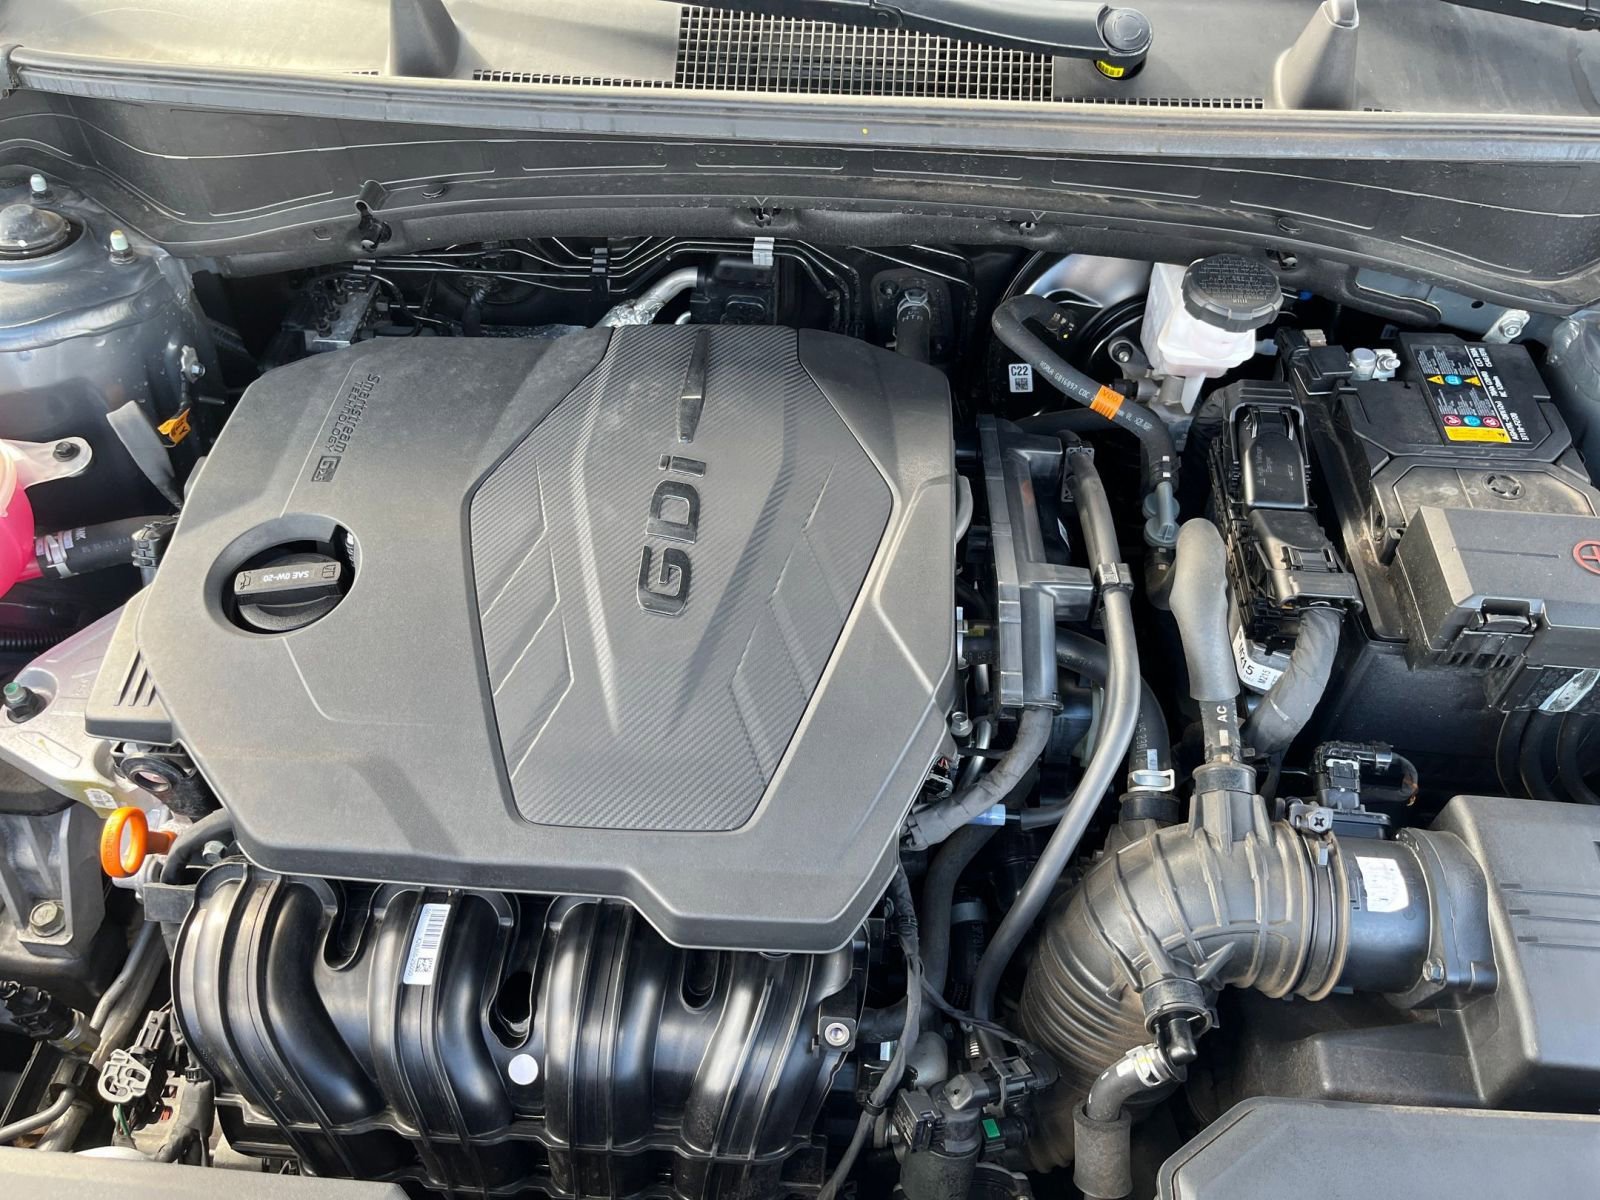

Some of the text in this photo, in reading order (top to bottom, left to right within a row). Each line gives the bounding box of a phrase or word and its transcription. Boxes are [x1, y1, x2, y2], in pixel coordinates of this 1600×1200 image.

[1010, 365, 1029, 377] C22
[325, 381, 364, 453] TECHNOLOGY
[334, 374, 381, 454] Smartstream
[637, 453, 706, 617] GDi
[263, 570, 310, 583] SAE 0W-20
[1216, 705, 1228, 723] AC
